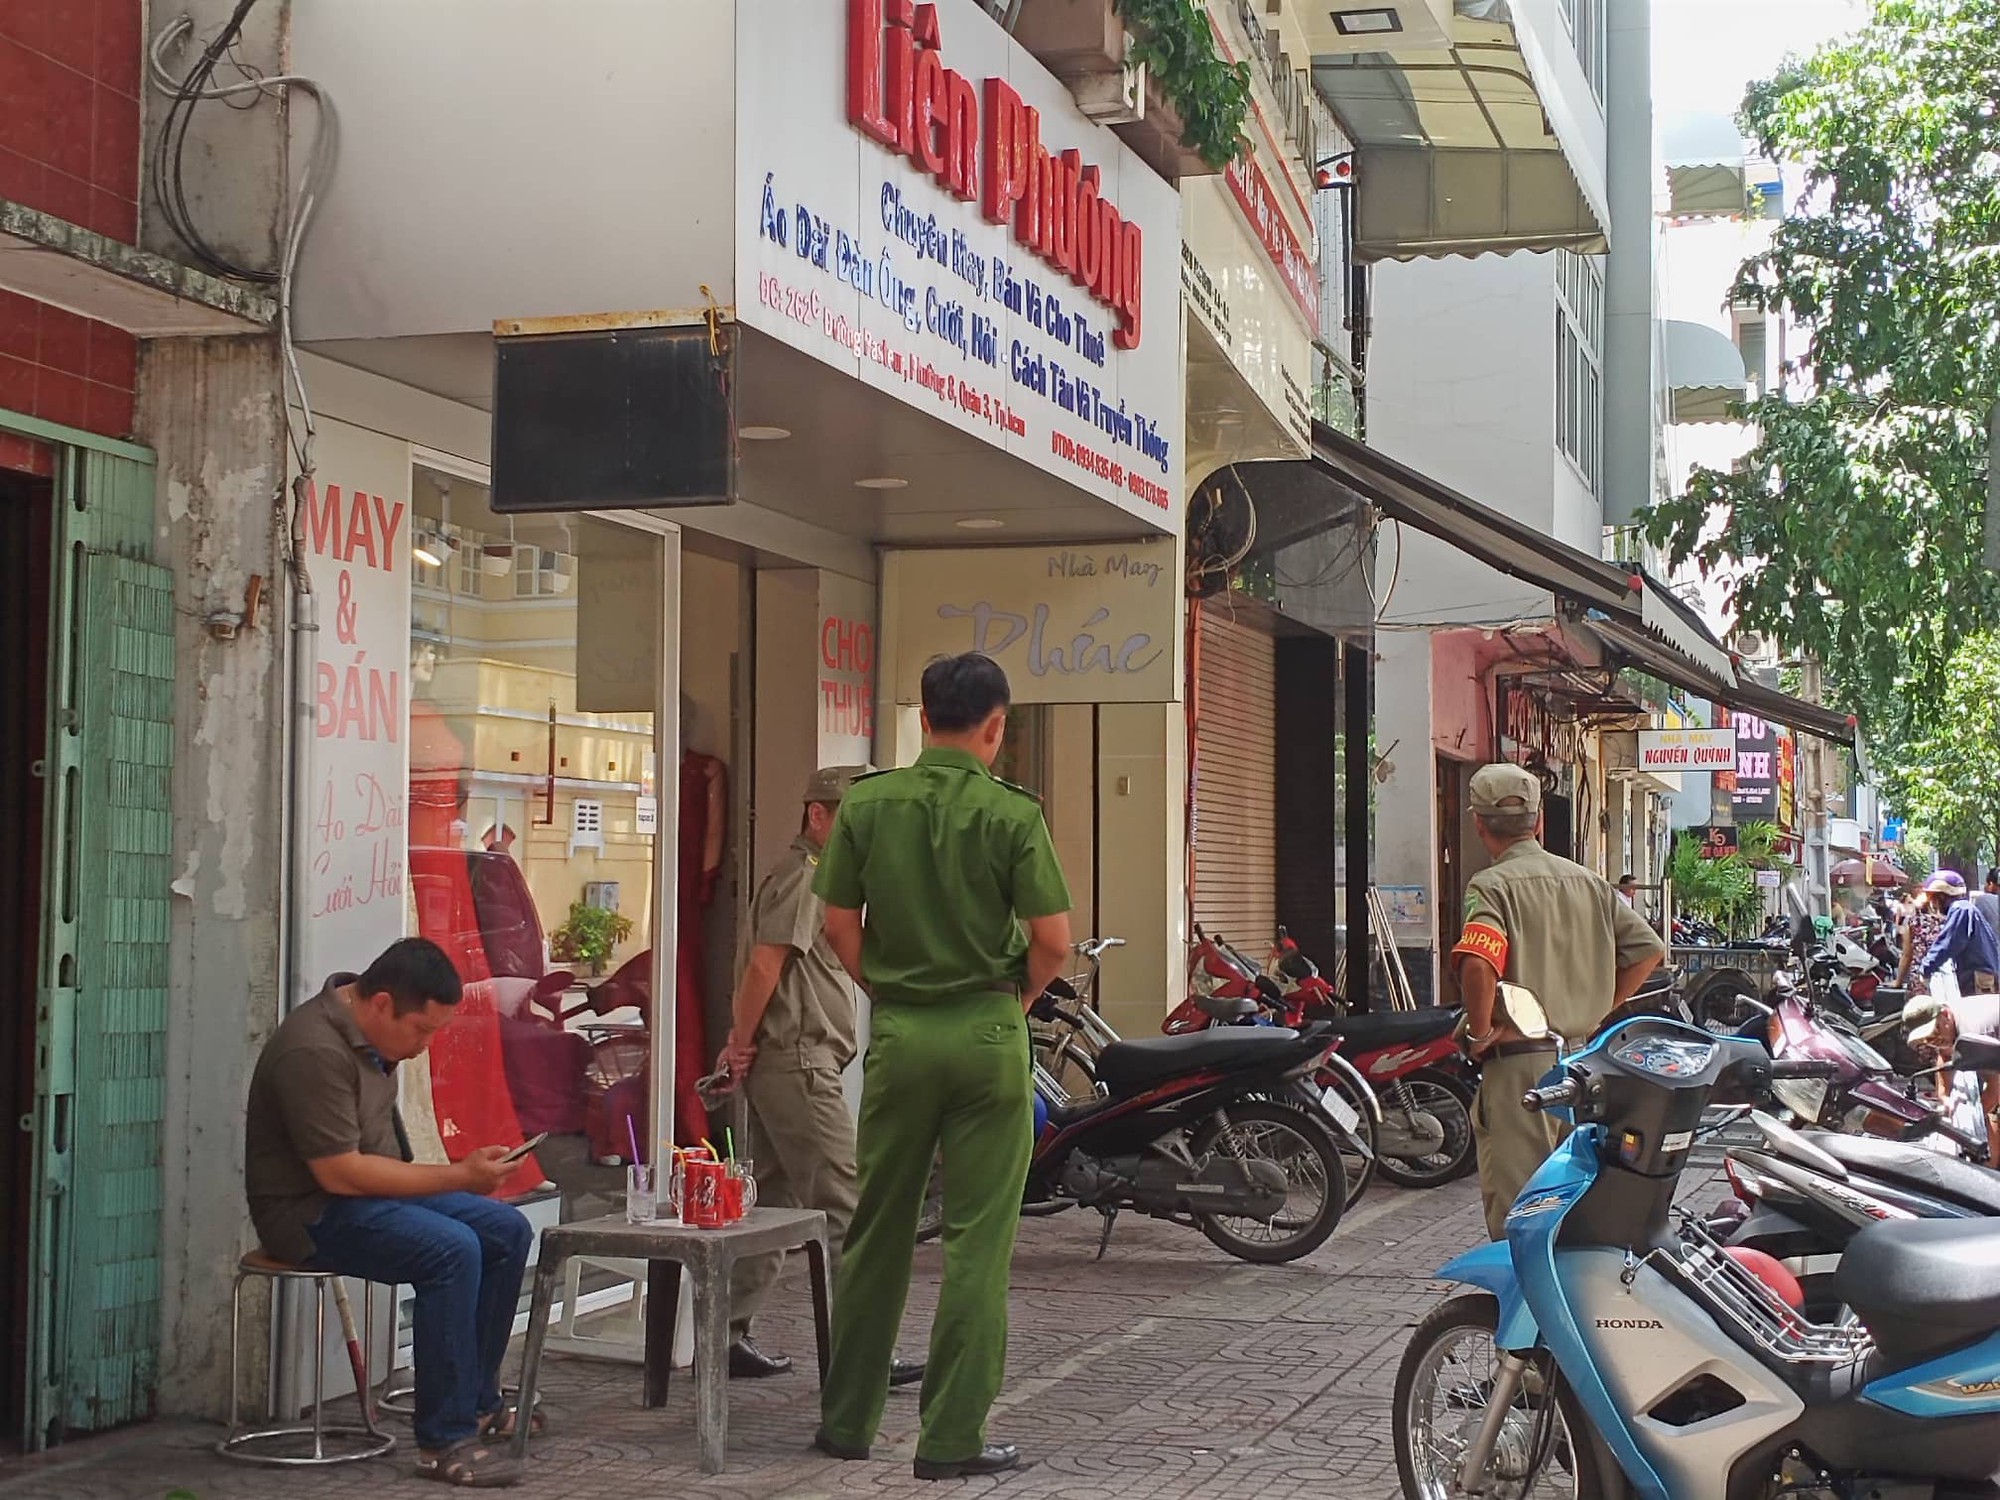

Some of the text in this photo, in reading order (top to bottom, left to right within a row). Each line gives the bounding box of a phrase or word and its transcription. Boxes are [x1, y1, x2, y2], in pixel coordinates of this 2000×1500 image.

[984, 77, 1143, 349] Phương
[881, 181, 1105, 368] Chuyên May, Bán Và Cho Thuê
[760, 172, 787, 248] Áo
[797, 204, 830, 273] Dài
[836, 230, 874, 299] Đàn
[1011, 340, 1046, 396] Cách
[1050, 361, 1074, 412] Tân
[1075, 377, 1091, 423] Và
[1092, 387, 1133, 446] Truyền
[1134, 413, 1169, 473] Thống
[303, 481, 405, 573] MAY
[1047, 551, 1096, 579] Nhà
[336, 568, 358, 645] &
[821, 616, 874, 674] CHO
[315, 650, 398, 744] BÁN
[1736, 752, 1771, 779] NH
[1595, 1319, 1664, 1329] HONDA
